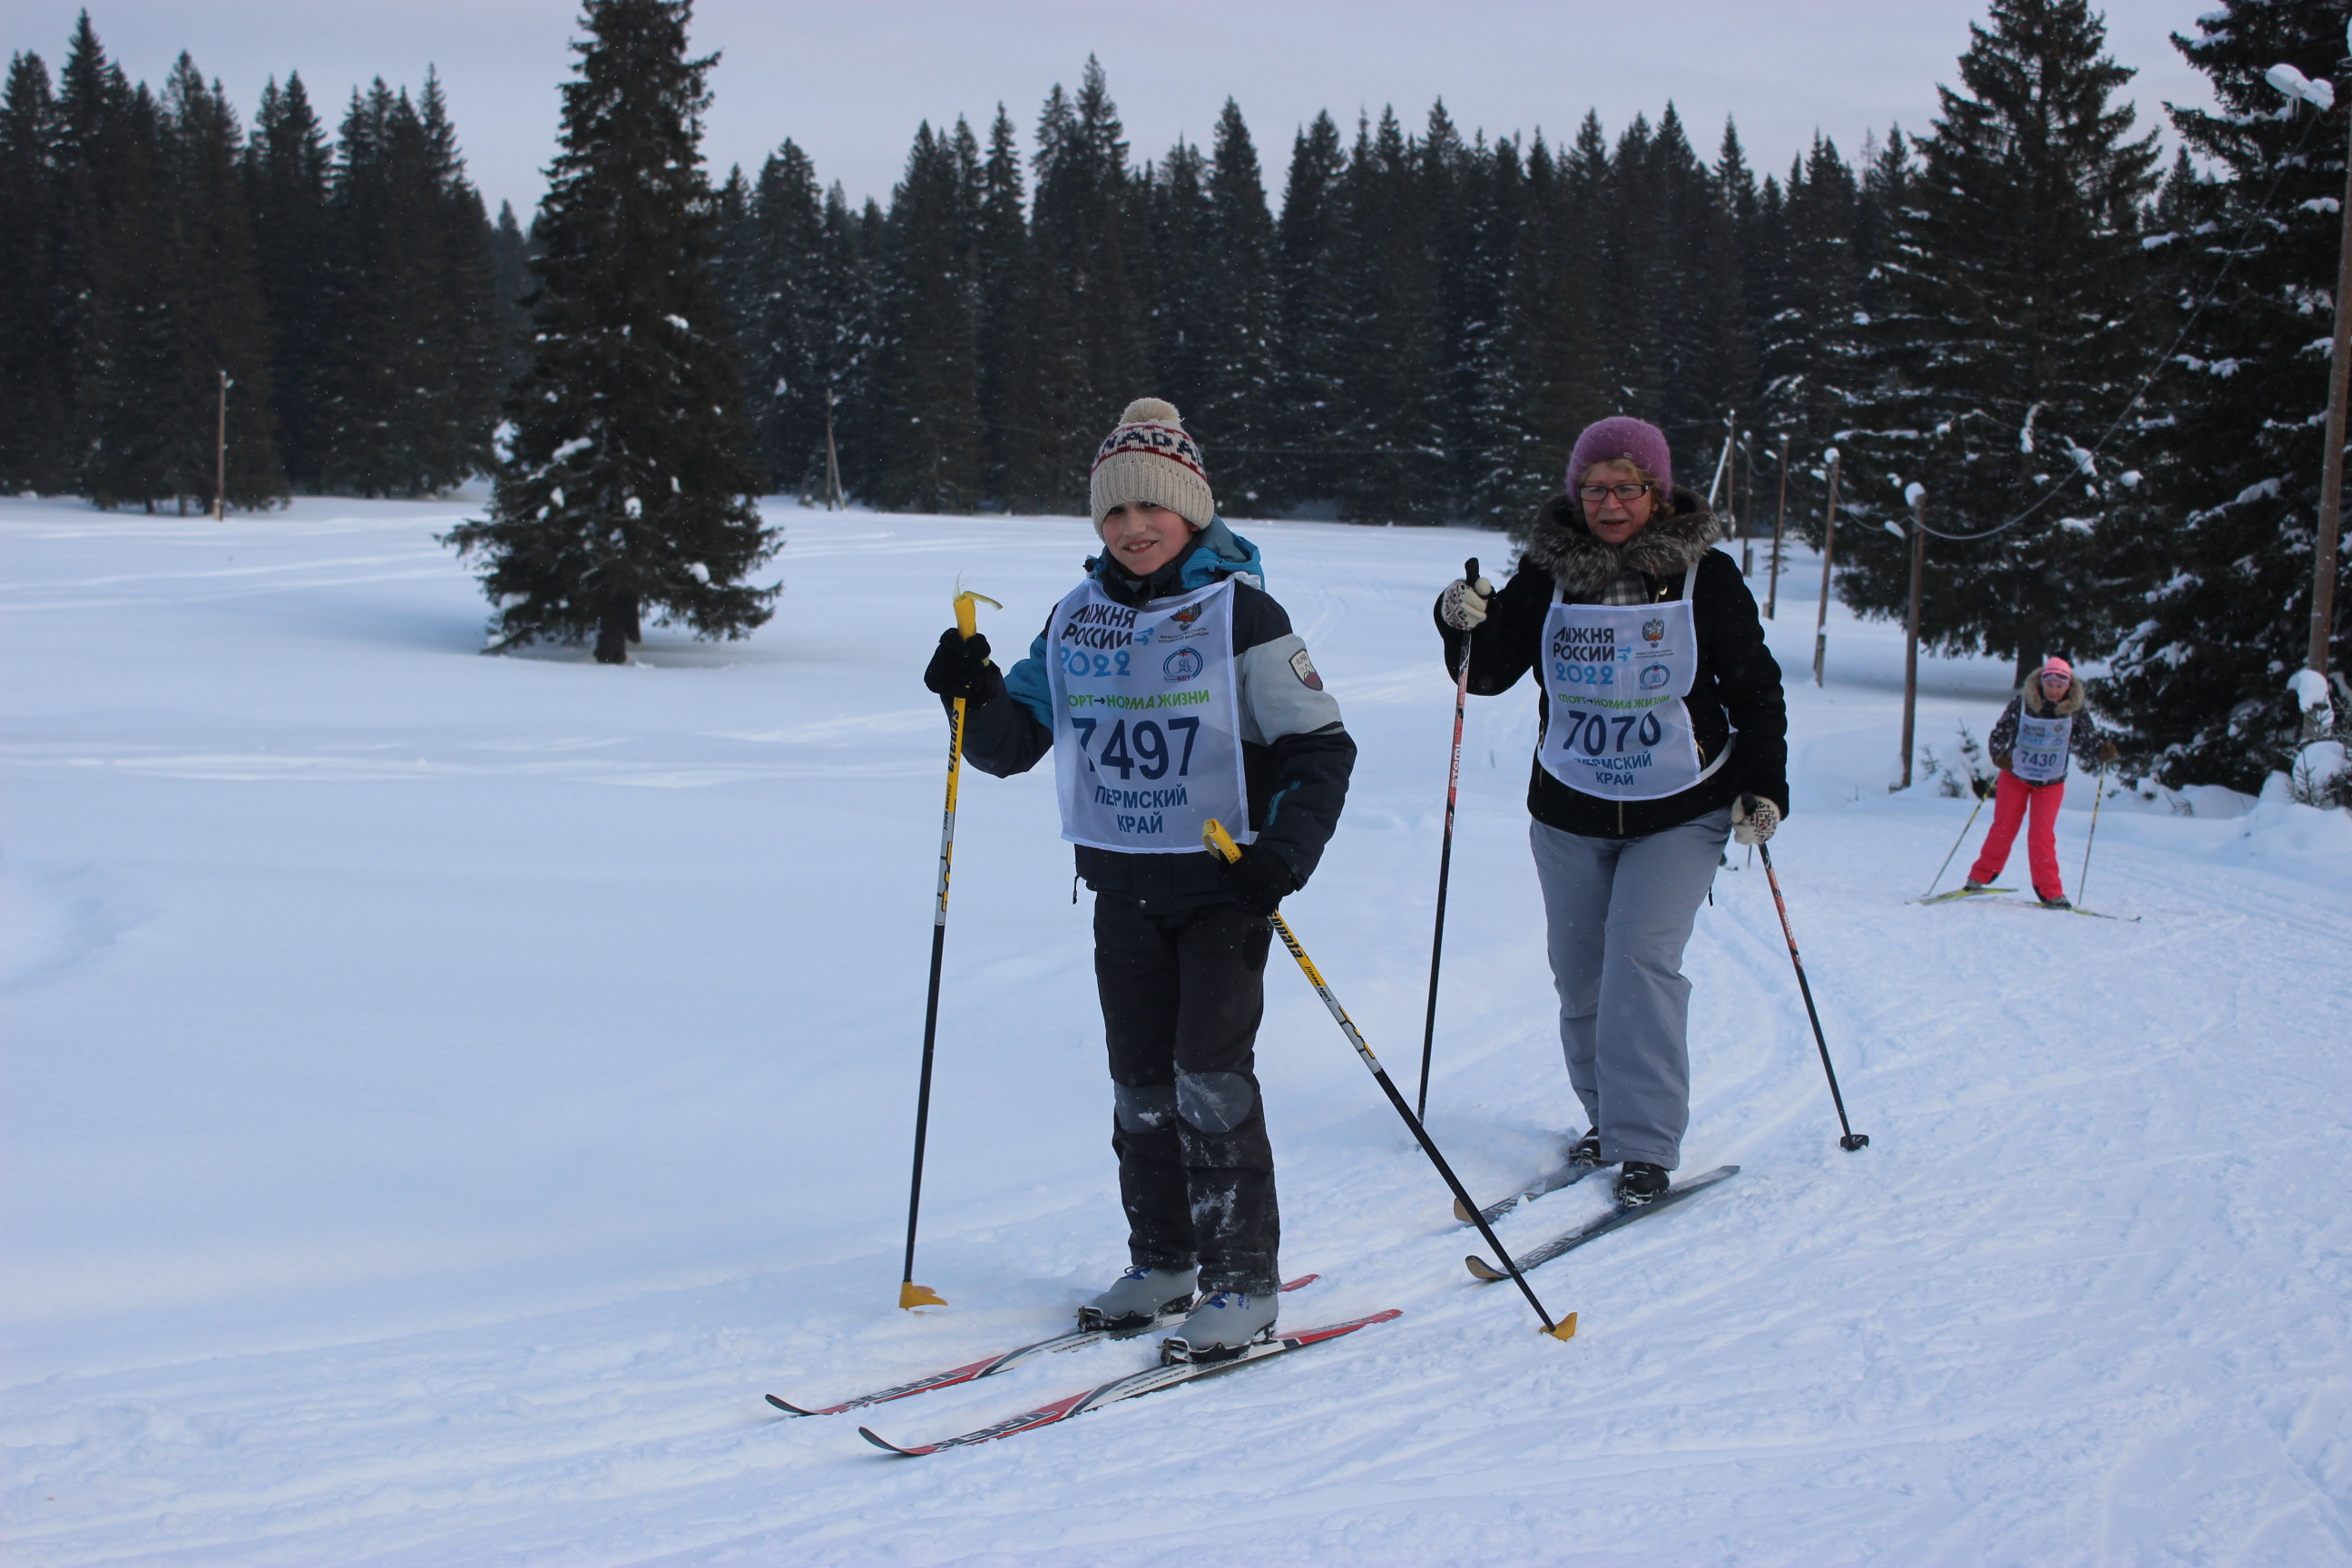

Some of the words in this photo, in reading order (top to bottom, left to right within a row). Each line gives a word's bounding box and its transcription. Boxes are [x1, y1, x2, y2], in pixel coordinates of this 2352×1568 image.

[1061, 622, 1133, 650] РОССИИ
[1553, 642, 1615, 662] РОССИИ
[1555, 662, 1614, 685] 2022
[1068, 694, 1094, 708] ОРТ
[1106, 694, 1155, 710] НОРМА
[1157, 689, 1210, 708] ЖИЗНИ
[1558, 693, 1586, 705] СПОРТ
[1593, 697, 1632, 710] НОРМА
[1632, 694, 1671, 708] ЖИЗНИ
[1563, 710, 1661, 757] 7070
[1071, 716, 1200, 780] 7497
[2021, 750, 2058, 768] 7430
[1595, 771, 1634, 786] КРАЙ
[1094, 783, 1189, 809] ПЕРМСКИЙ
[1116, 811, 1164, 834] КРАЙ
[846, 1371, 971, 1409] TREK
[931, 1411, 1059, 1451] TREK
